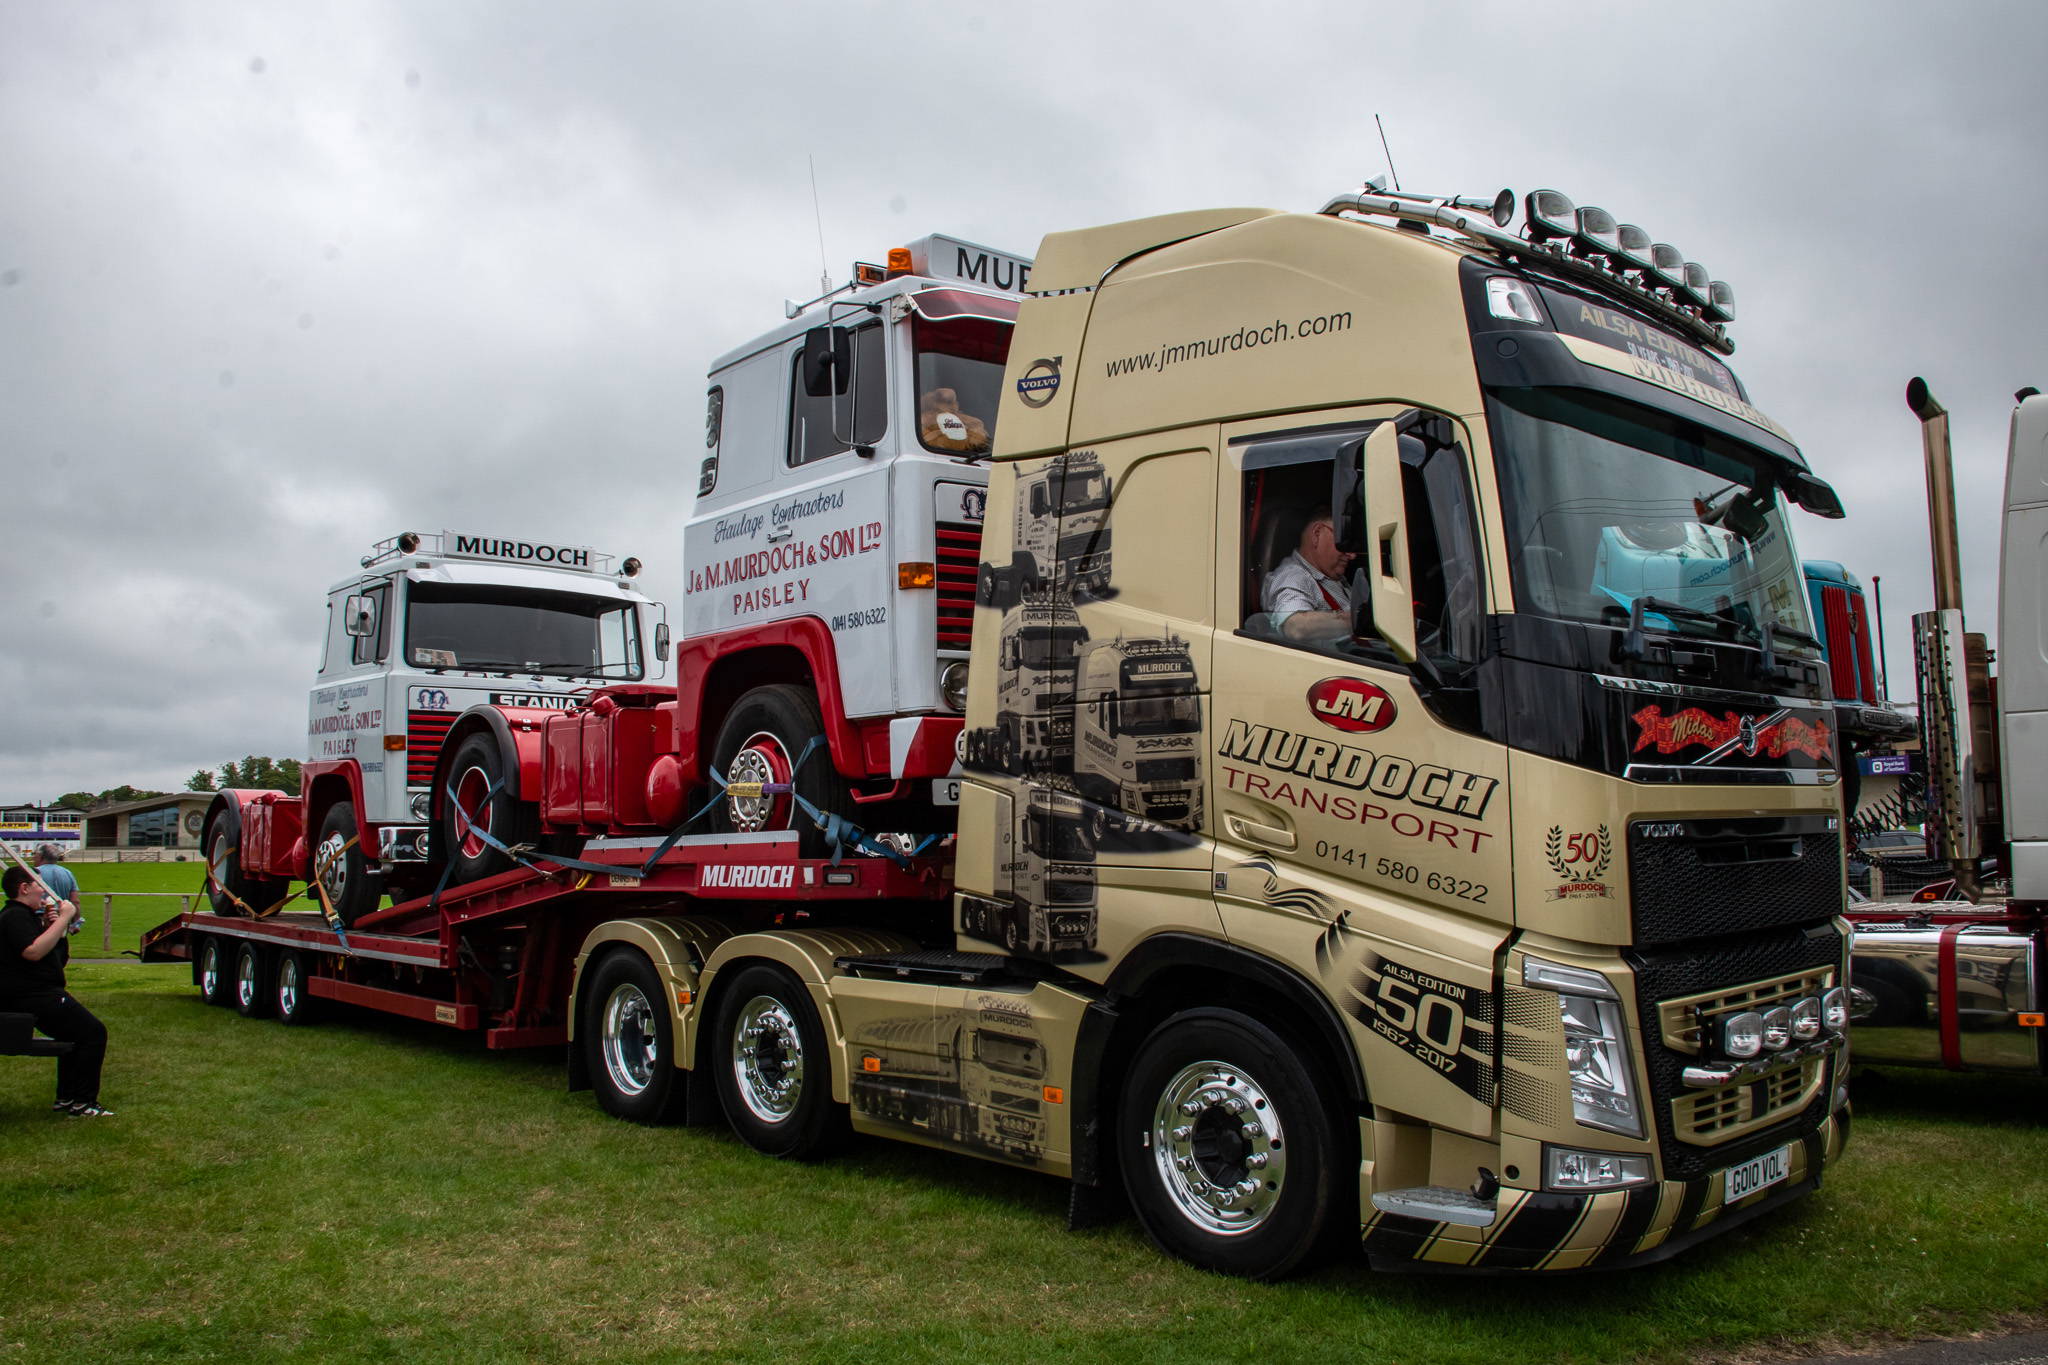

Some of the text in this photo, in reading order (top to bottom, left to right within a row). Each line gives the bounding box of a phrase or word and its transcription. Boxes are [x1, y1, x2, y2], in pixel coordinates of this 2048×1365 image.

[1106, 311, 1352, 378] www.jmmurdoch.com
[1579, 305, 1714, 375] AILSA EDITION
[1020, 379, 1058, 389] VOLVO
[1632, 357, 1774, 431] MURDOCH
[714, 489, 844, 545] Haulage Contractors
[456, 535, 589, 567] MURDOCH
[820, 528, 855, 562] SON
[733, 578, 810, 615] PAISLEY
[832, 606, 886, 632] 0141 580 6322
[1136, 661, 1182, 674] MURDOCH
[499, 694, 578, 712] SCANIA
[1671, 716, 1716, 742] Midas
[323, 738, 357, 756] PAISLEY
[1218, 718, 1500, 821] MURDOCH
[1222, 766, 1493, 854] TRANSPORT
[1638, 823, 1685, 838] VOLVO
[1564, 832, 1599, 864] 50
[701, 865, 795, 888] MURDOCH
[1315, 840, 1489, 904] 0141 580 6322
[1558, 882, 1606, 898] MURDOCH
[1383, 963, 1467, 1001] AILSA EDITION
[1376, 975, 1465, 1057] 50
[1760, 1153, 1783, 1182] VOL
